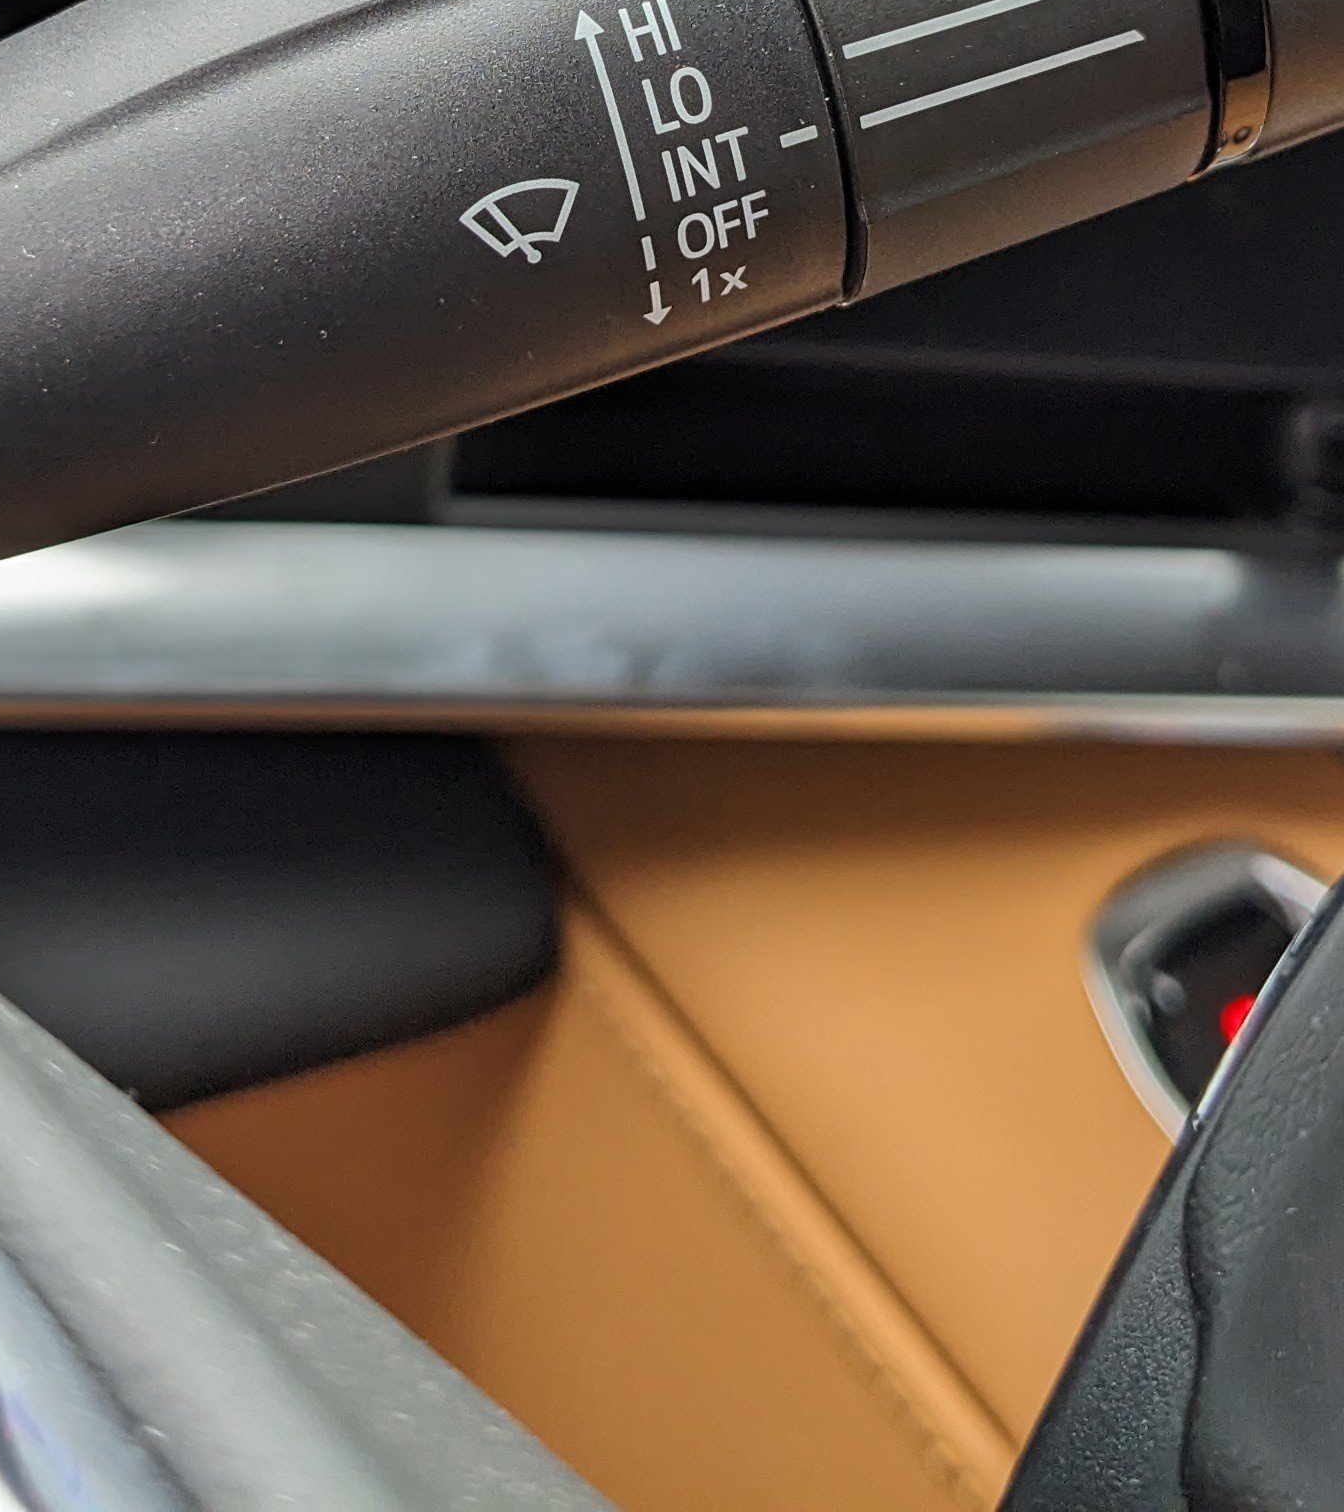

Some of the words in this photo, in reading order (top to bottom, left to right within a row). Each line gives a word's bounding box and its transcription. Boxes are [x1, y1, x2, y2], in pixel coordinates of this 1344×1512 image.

[641, 66, 712, 135] LO
[661, 126, 749, 202] INT
[677, 190, 769, 261] OFF
[692, 266, 748, 303] 1x
